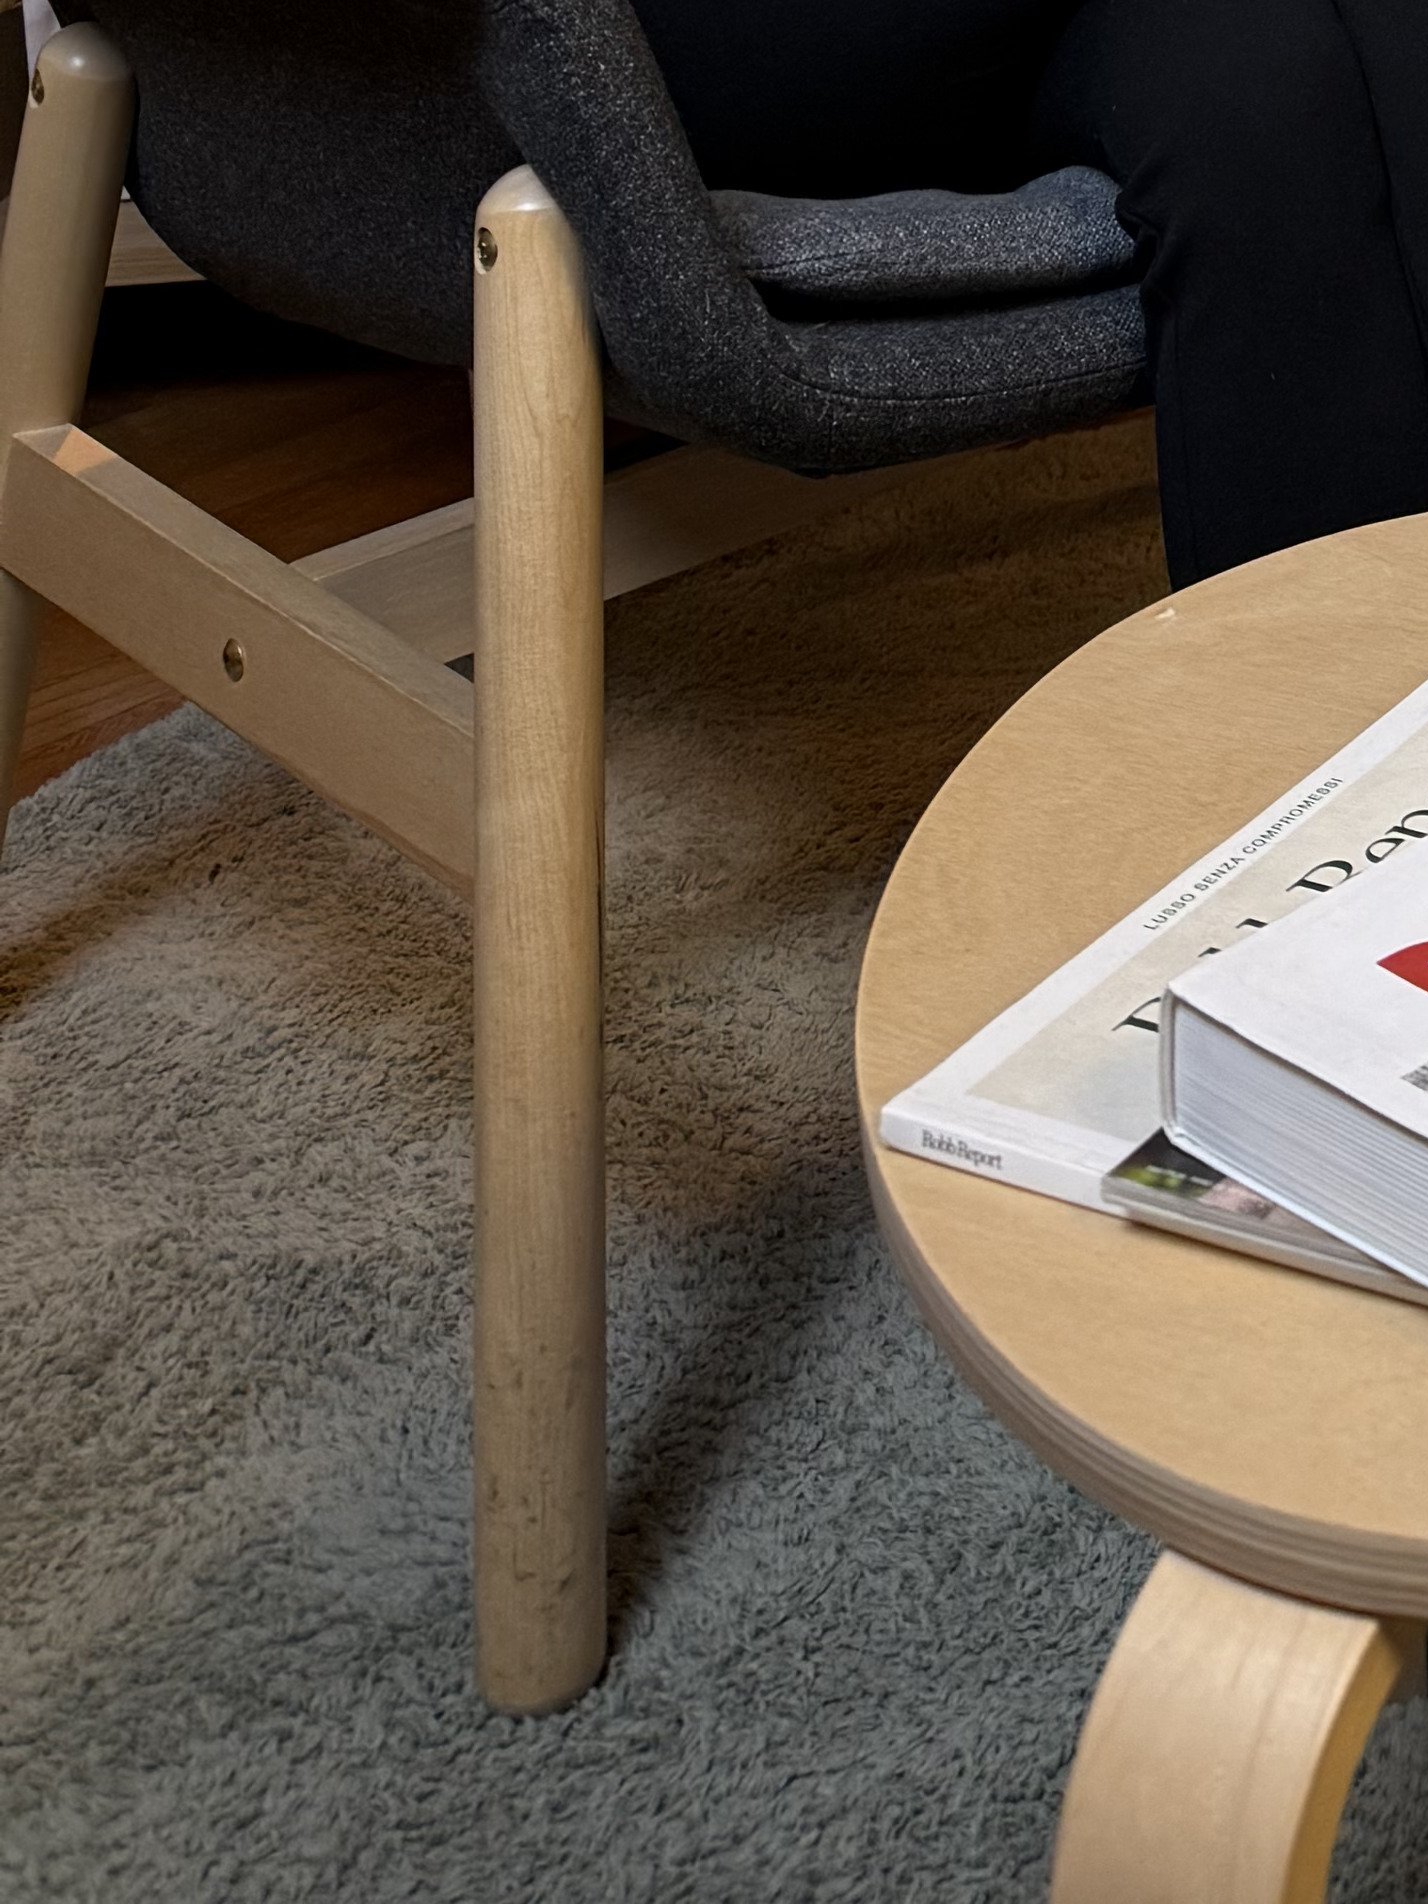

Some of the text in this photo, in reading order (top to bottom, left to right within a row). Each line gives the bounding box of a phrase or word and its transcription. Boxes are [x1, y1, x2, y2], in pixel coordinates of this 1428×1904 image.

[1143, 776, 1344, 931] LUSSO SENZA COMPROMESSI
[921, 1129, 1003, 1172] Robb Report
